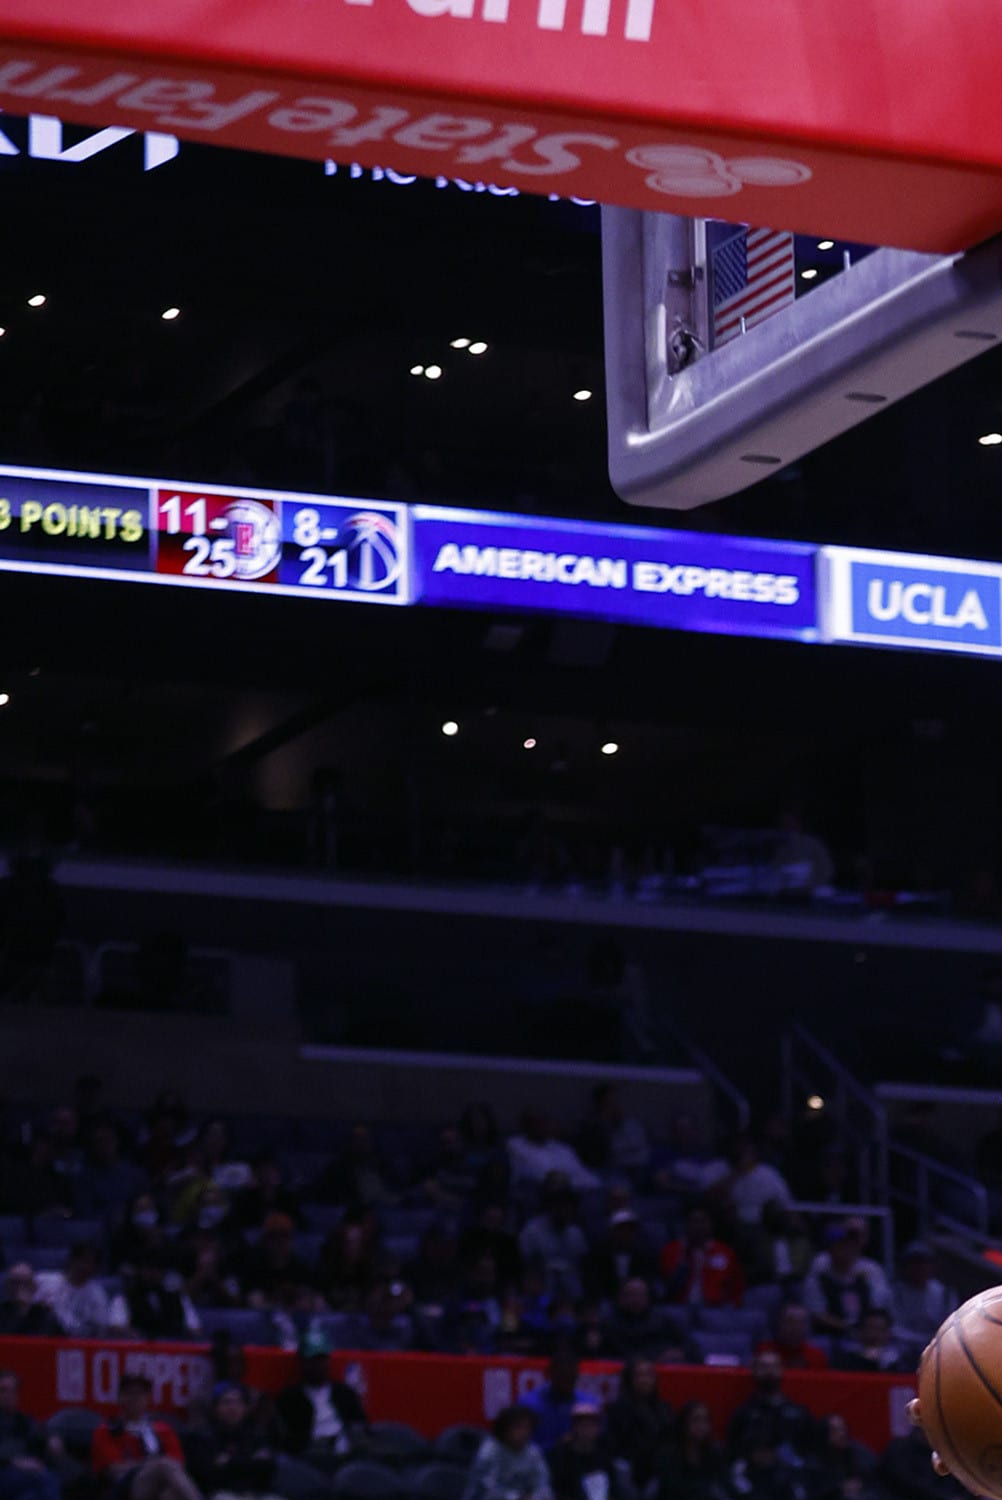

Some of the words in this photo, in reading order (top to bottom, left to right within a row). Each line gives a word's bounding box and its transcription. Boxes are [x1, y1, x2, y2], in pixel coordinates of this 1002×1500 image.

[20, 501, 144, 543] POINTS
[182, 536, 237, 579] 25
[299, 548, 349, 588] 21
[432, 543, 628, 590] AMERICAN
[632, 561, 800, 606] EXPRESS
[866, 579, 989, 630] UCLA
